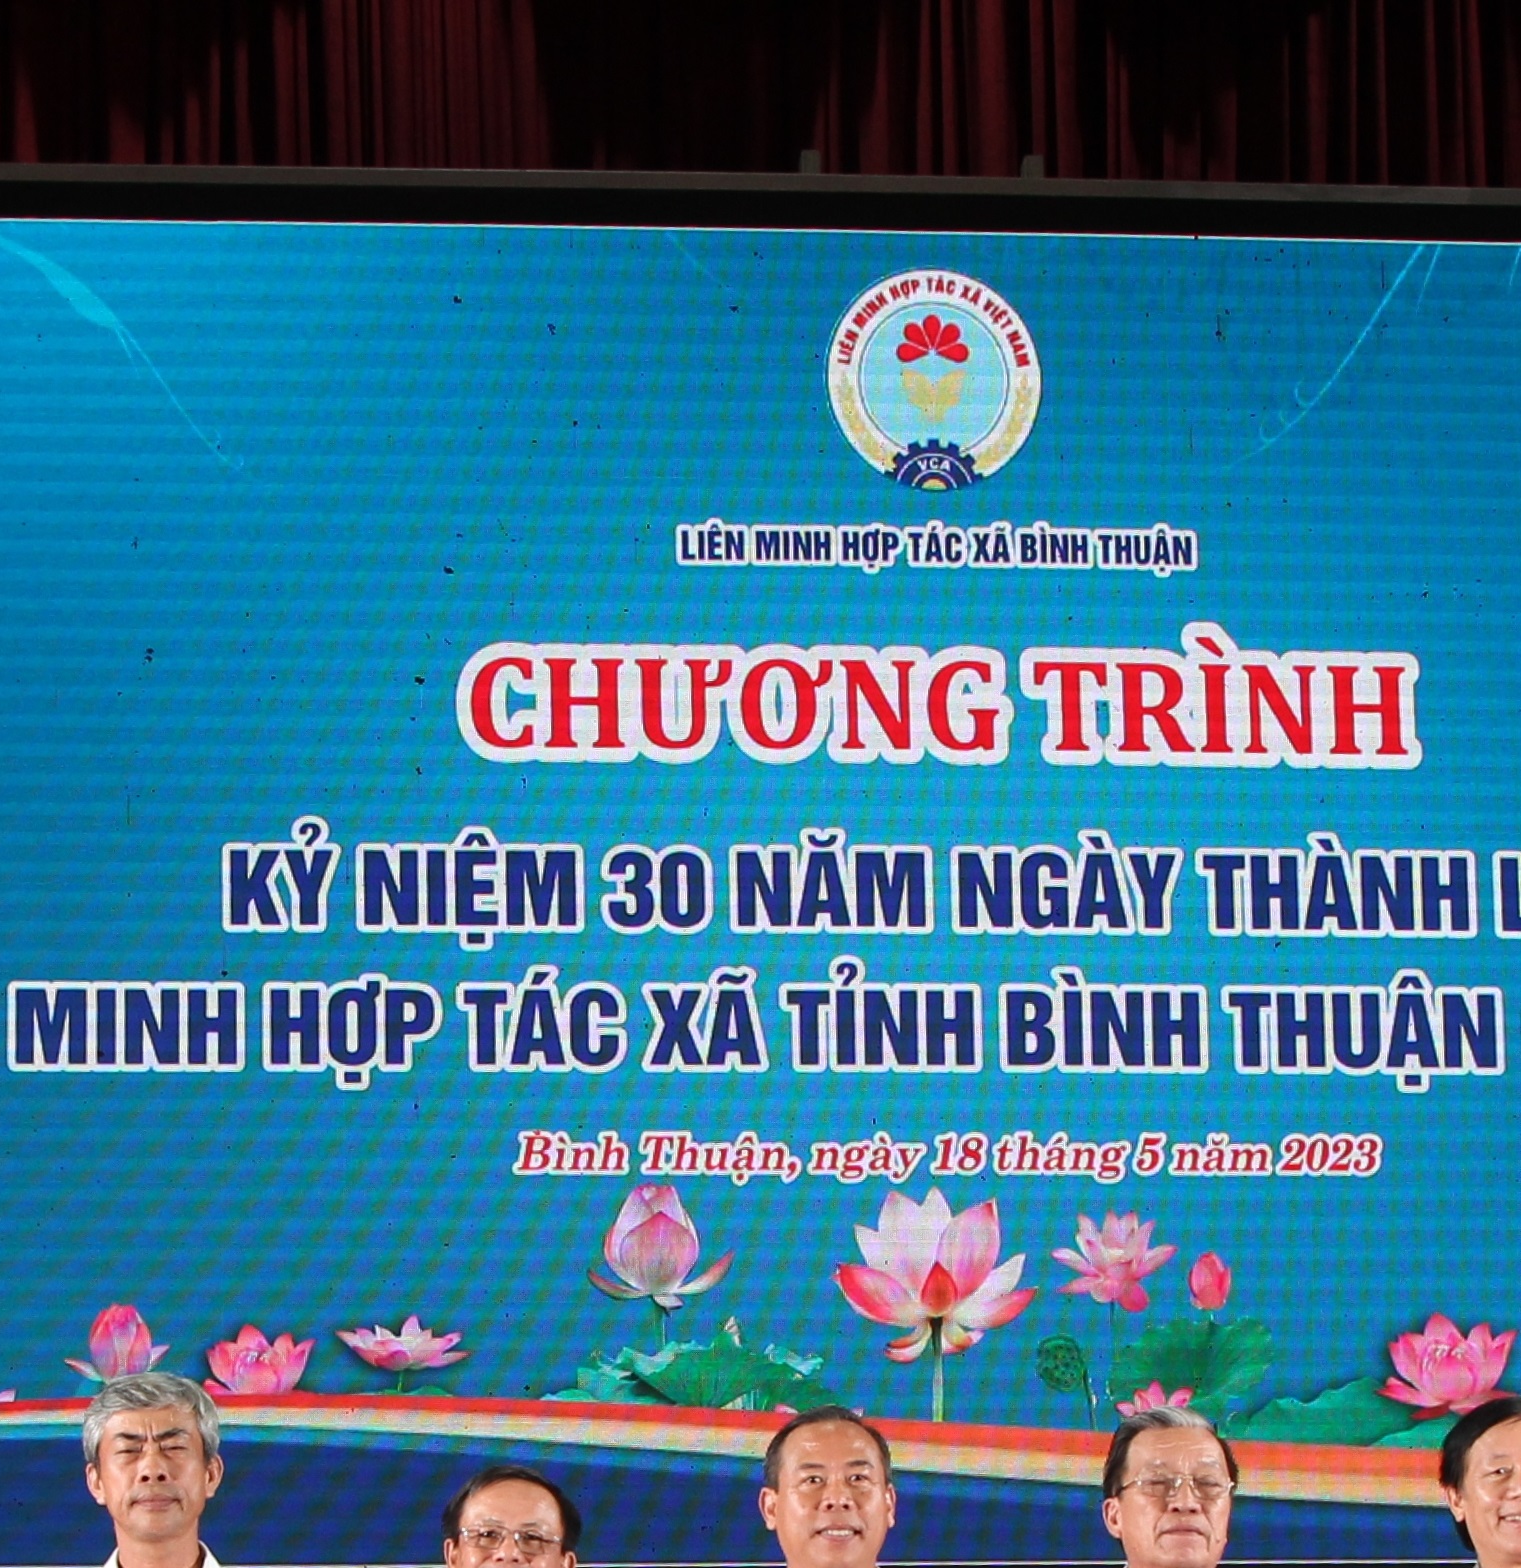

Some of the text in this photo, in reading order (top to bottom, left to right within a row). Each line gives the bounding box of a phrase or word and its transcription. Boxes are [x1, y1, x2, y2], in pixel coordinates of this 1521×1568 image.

[837, 276, 1030, 368] LIÊN MINH HỢP TÁC XÃ VIỆT NAM
[917, 458, 951, 471] VCA
[680, 523, 1193, 573] LIÊN MINH HỢP TÁC XÃ BÌNH THUẬN
[471, 636, 1408, 756] CHƯƠNG TRÌNH
[229, 824, 332, 926] KỶ
[362, 832, 577, 944] NIỆM
[608, 850, 705, 929] 30
[736, 832, 925, 928] NĂM
[958, 838, 1178, 929] NGÀY
[1203, 839, 1470, 932] THÀNH
[15, 988, 238, 1065] MINH
[269, 981, 435, 1084] HỢP
[464, 971, 619, 1068] TÁC
[649, 972, 761, 1068] XÃ
[788, 962, 975, 1068] TỈNH
[1008, 972, 1200, 1069] BÌNH
[1229, 975, 1497, 1088] THUẬN
[643, 1135, 798, 1181] Thuận,
[812, 1135, 924, 1180] ngày
[935, 1136, 982, 1172] 18
[997, 1134, 1124, 1180] tháng
[1137, 1137, 1162, 1172] 5
[1173, 1137, 1269, 1172] năm
[1280, 1138, 1378, 1172] 2023
